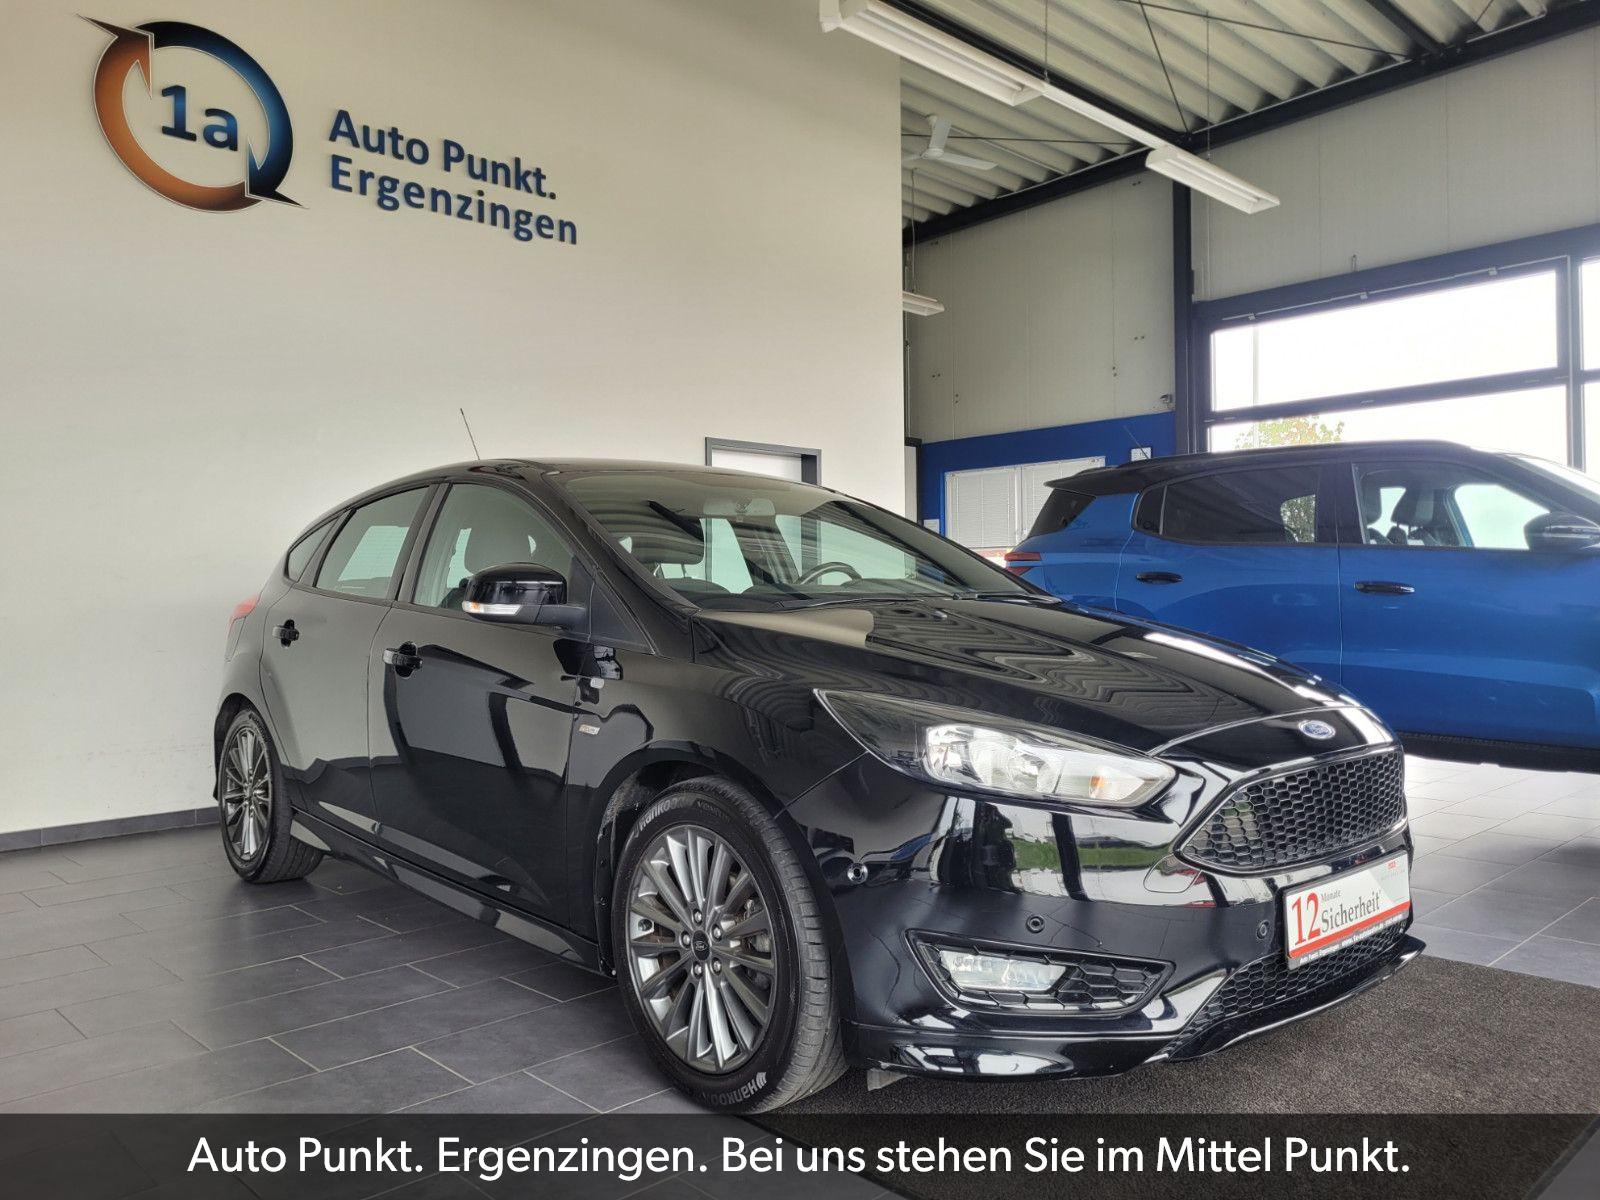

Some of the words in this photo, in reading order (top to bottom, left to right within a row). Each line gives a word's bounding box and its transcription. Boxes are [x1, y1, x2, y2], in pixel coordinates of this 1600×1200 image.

[161, 84, 239, 152] 1a
[329, 109, 430, 165] Auto
[443, 138, 557, 200] Punkt.
[330, 154, 578, 246] Ergenzingen
[1291, 892, 1321, 947] 12
[1321, 891, 1380, 933] Sicherheit
